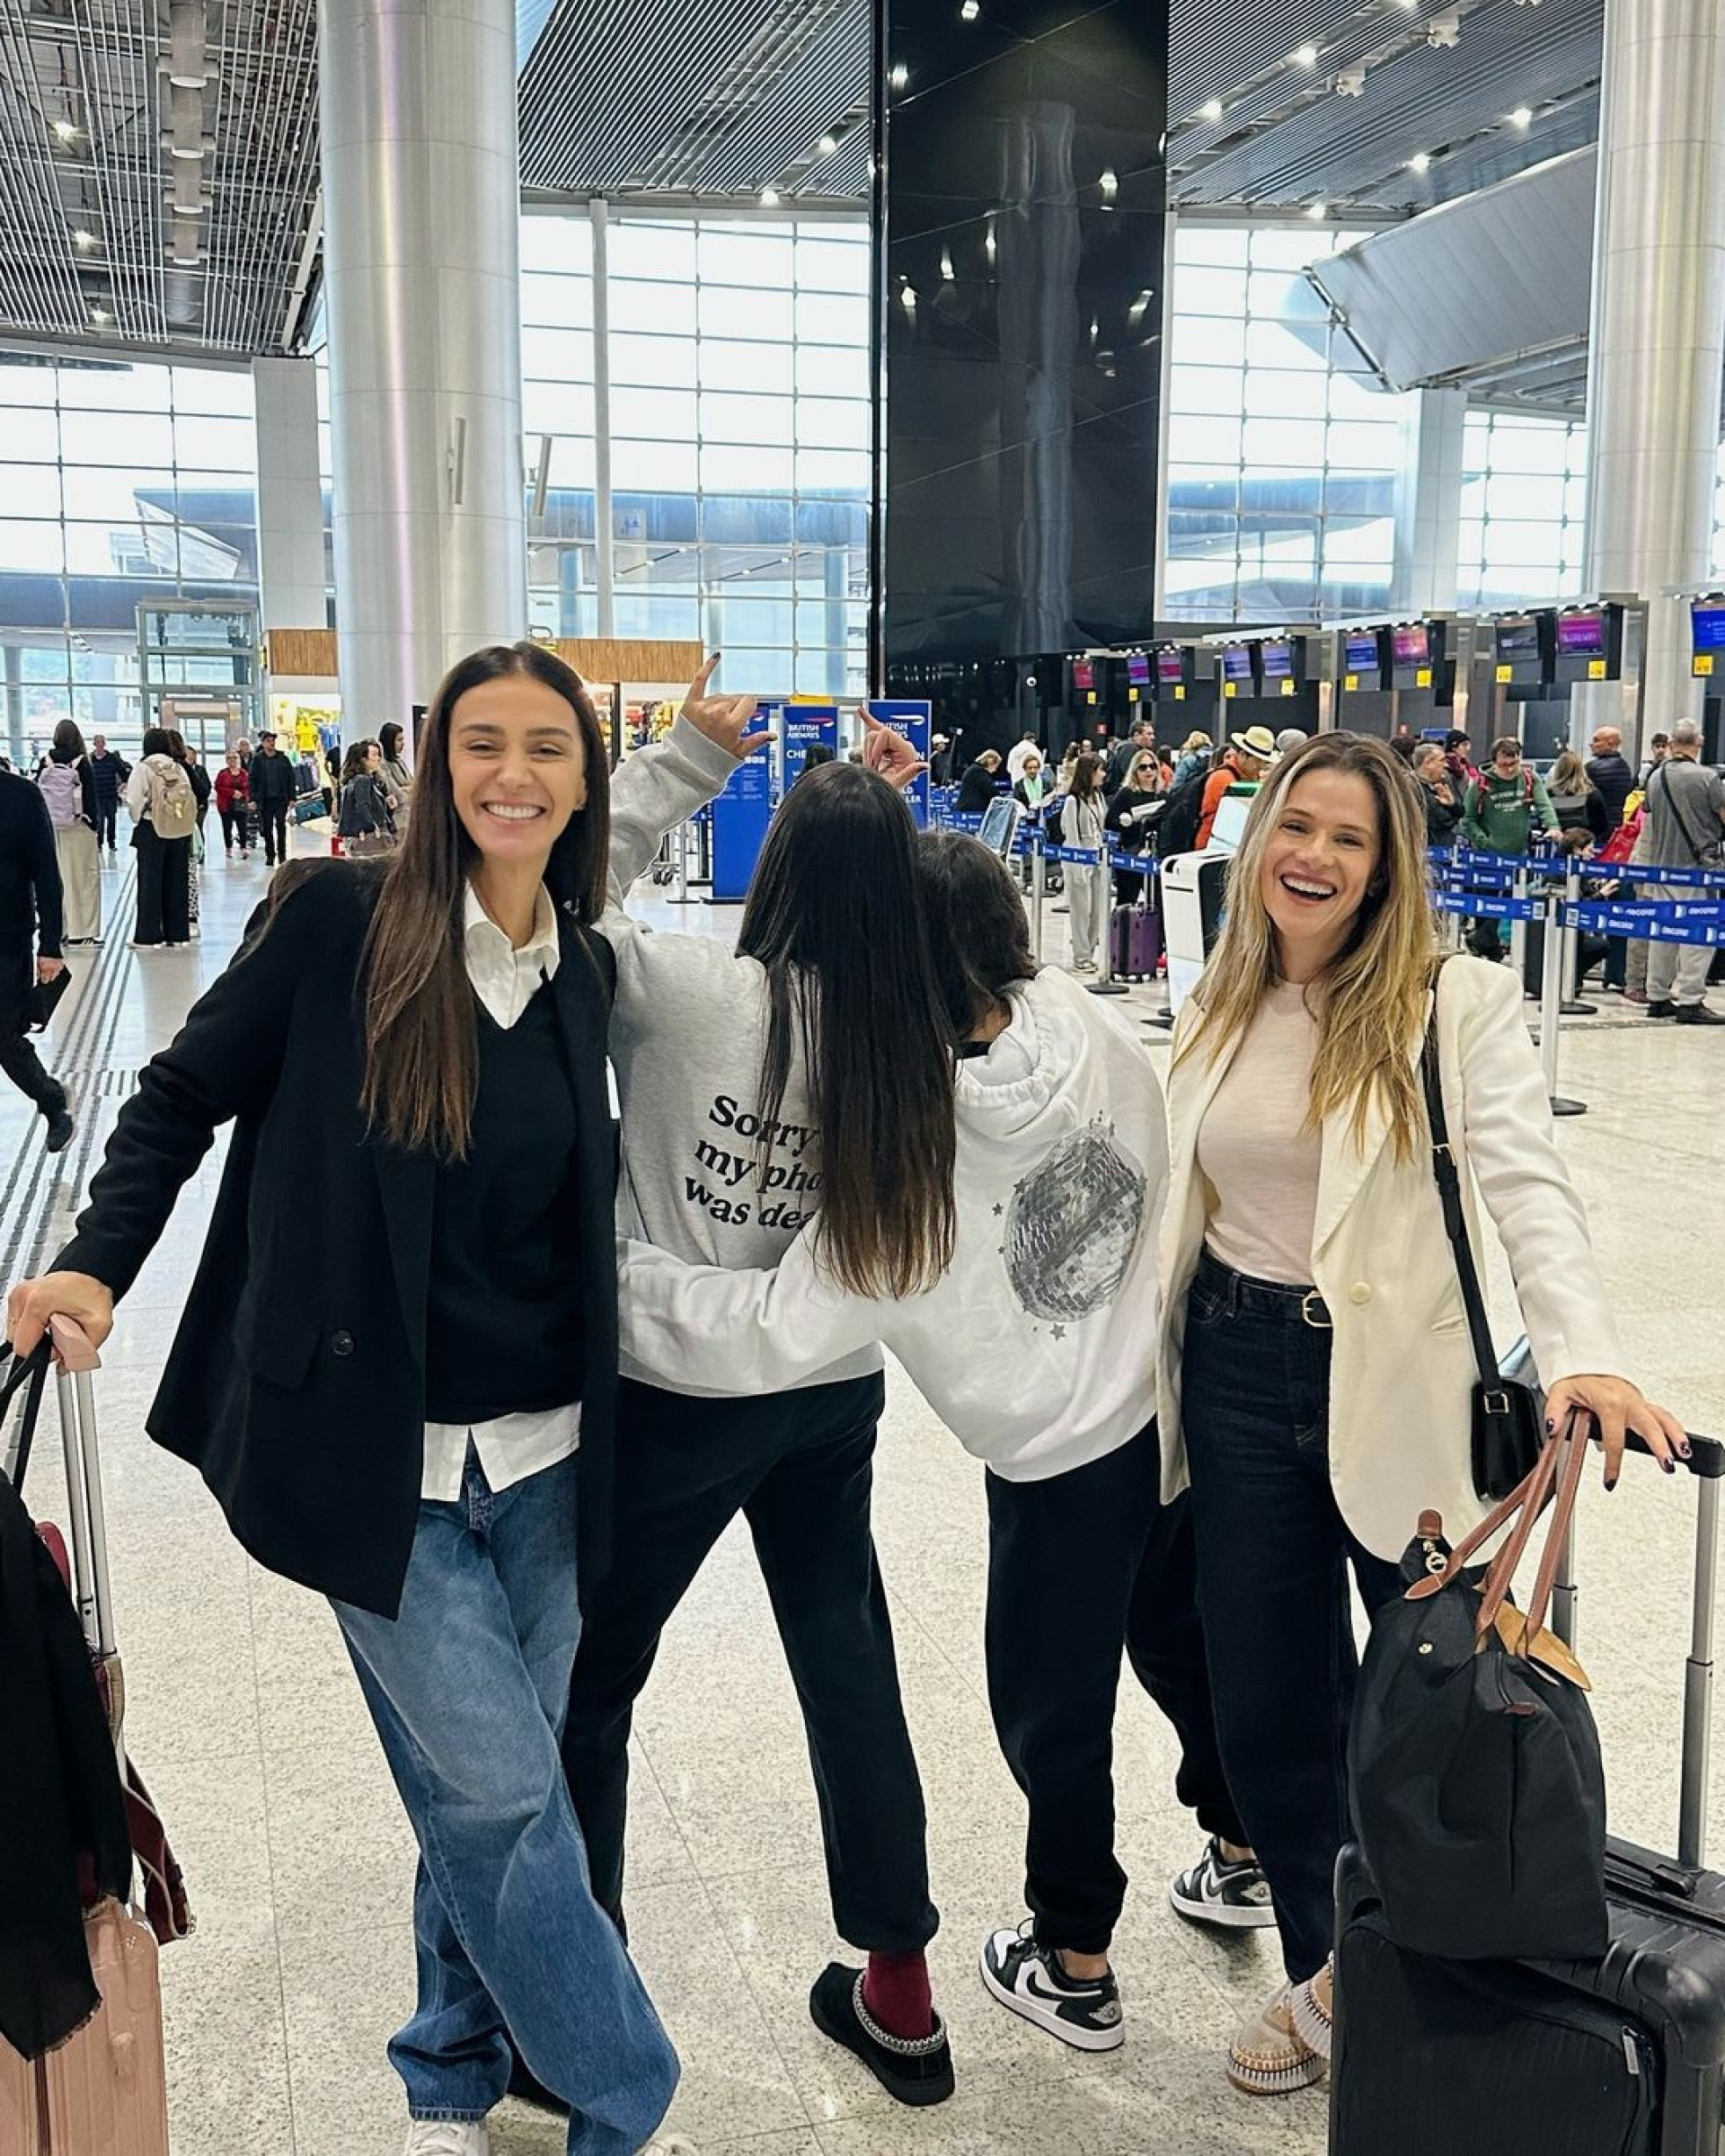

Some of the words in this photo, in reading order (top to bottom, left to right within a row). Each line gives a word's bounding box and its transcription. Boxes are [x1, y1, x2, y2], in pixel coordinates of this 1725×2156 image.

[786, 748, 808, 759] CHE
[788, 724, 820, 732] BRITISH
[709, 1094, 819, 1157] Sorry
[694, 1139, 757, 1187] my
[756, 1162, 826, 1194] pho
[685, 1176, 752, 1225] was
[757, 1202, 817, 1231] dea
